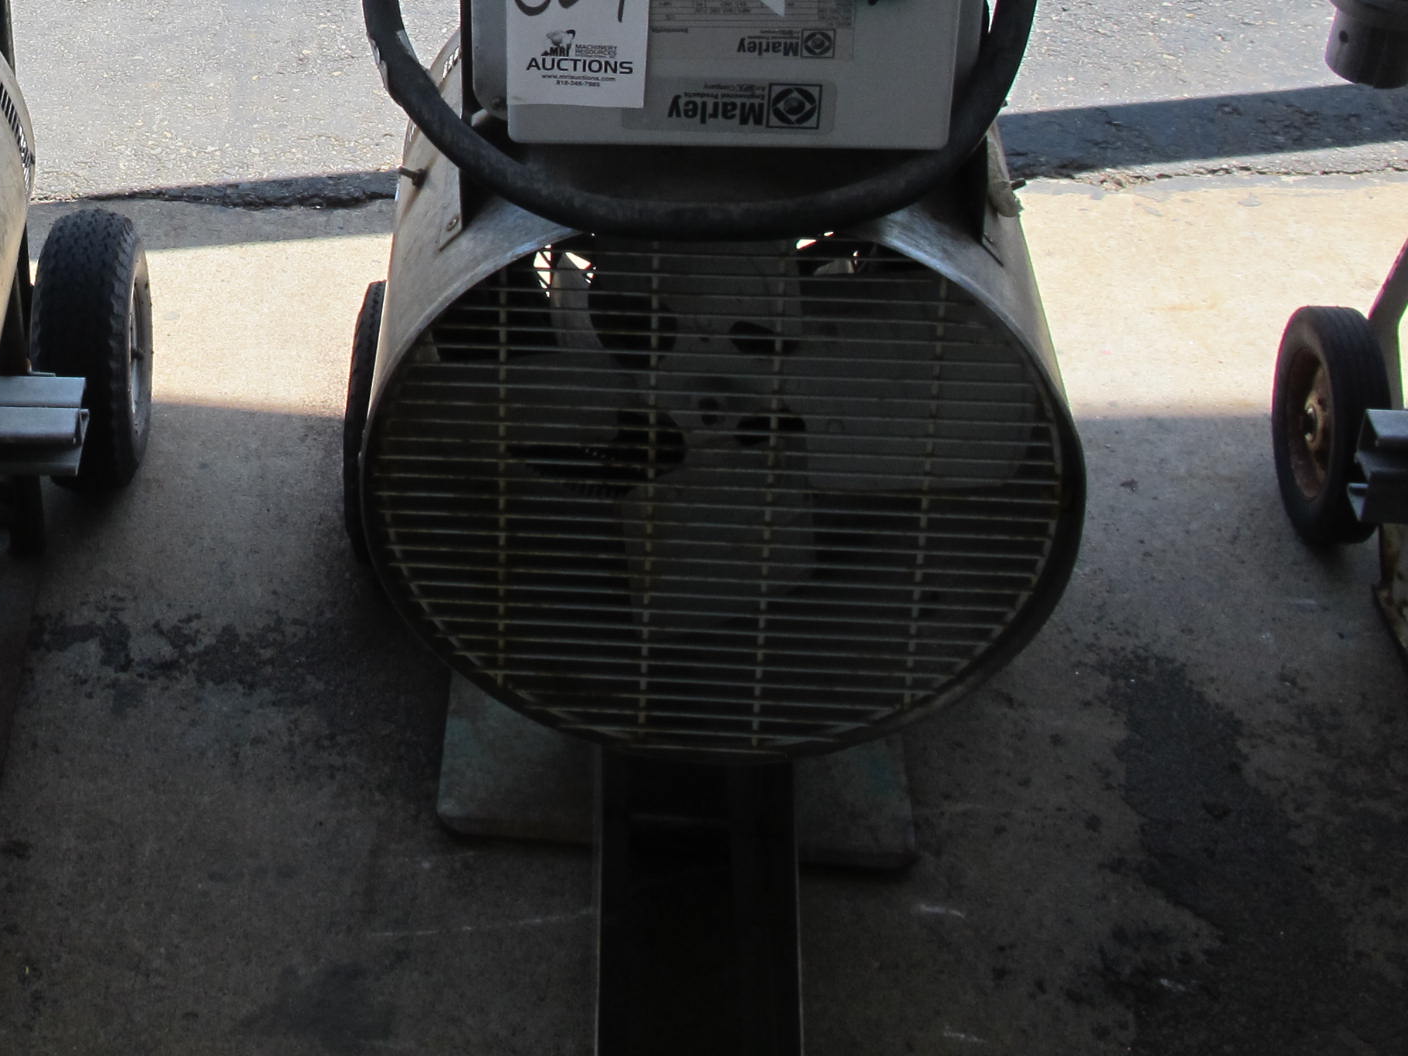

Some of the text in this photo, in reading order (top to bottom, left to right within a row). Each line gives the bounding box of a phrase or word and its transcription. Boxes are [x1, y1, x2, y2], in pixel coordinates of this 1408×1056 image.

[736, 38, 800, 56] Marley
[526, 57, 634, 74] AUCTIONS
[667, 94, 764, 126] Marley
